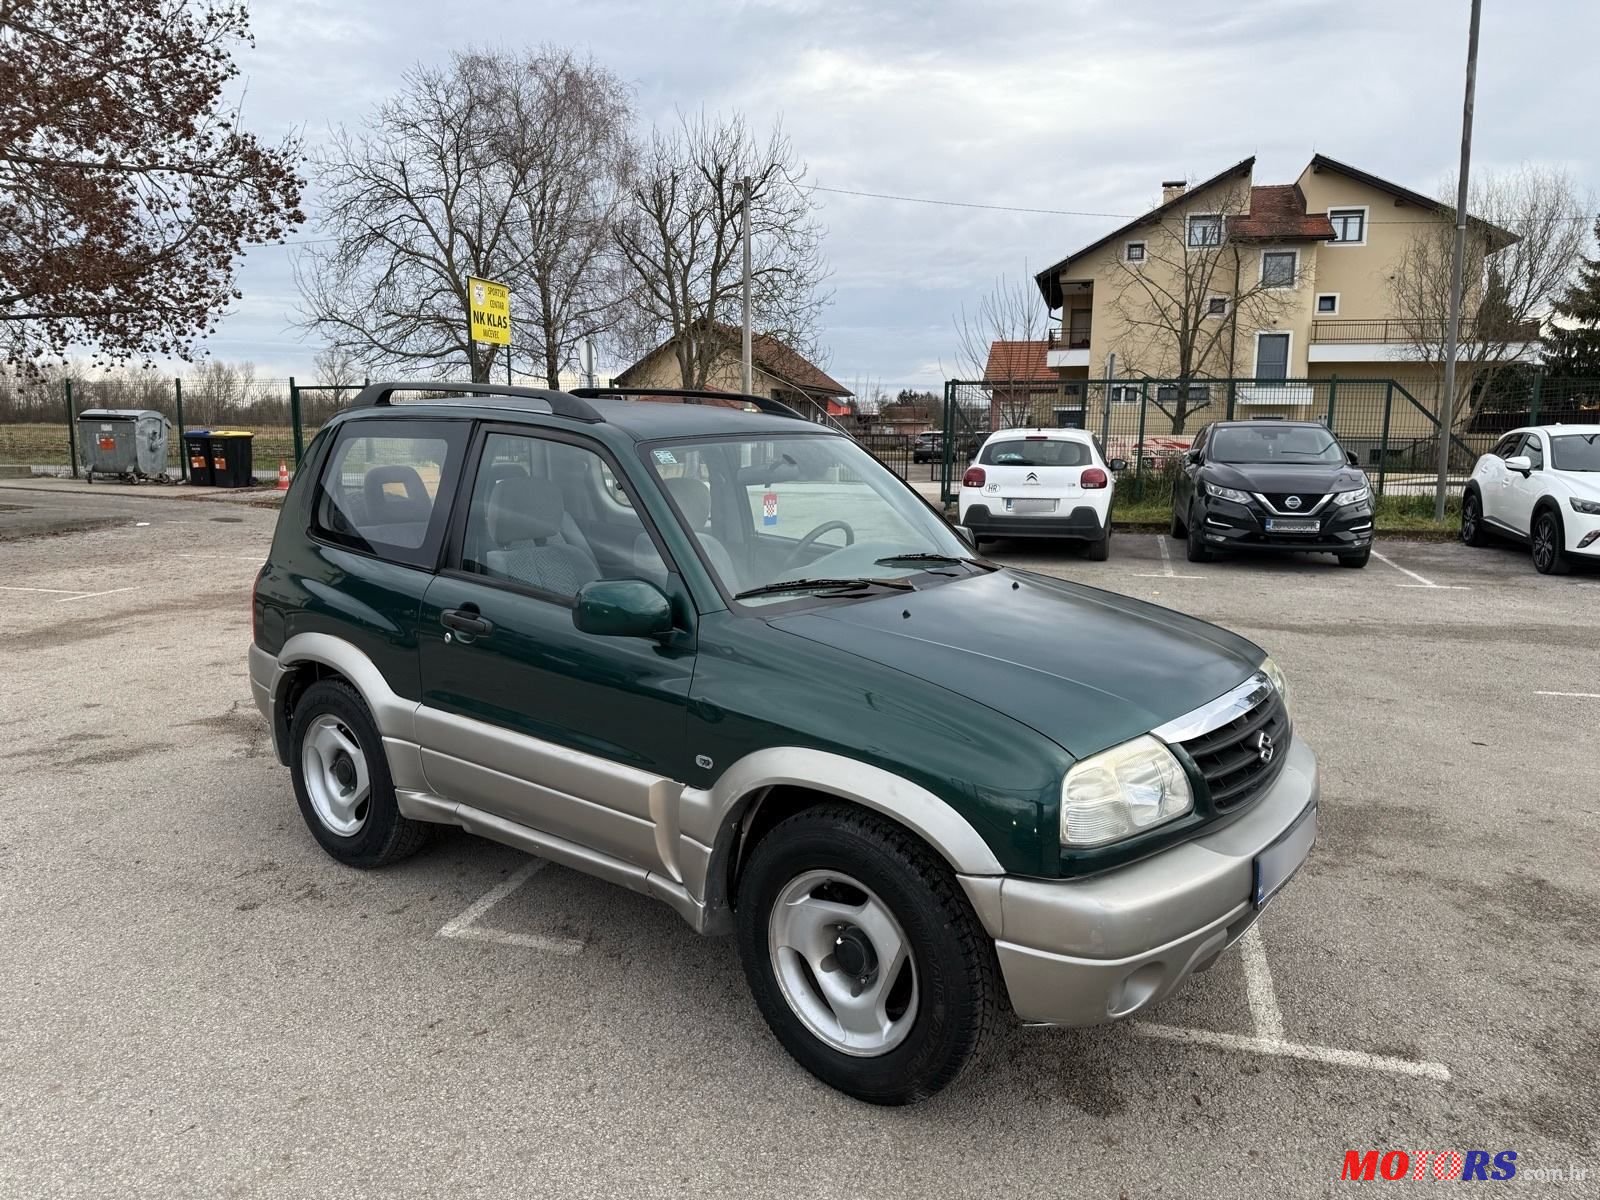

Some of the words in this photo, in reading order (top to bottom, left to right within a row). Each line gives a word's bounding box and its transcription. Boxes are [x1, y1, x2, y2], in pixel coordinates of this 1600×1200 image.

[490, 300, 504, 310] CENTAR
[473, 311, 485, 325] NK
[487, 312, 507, 329] KLAS
[988, 483, 998, 493] HR
